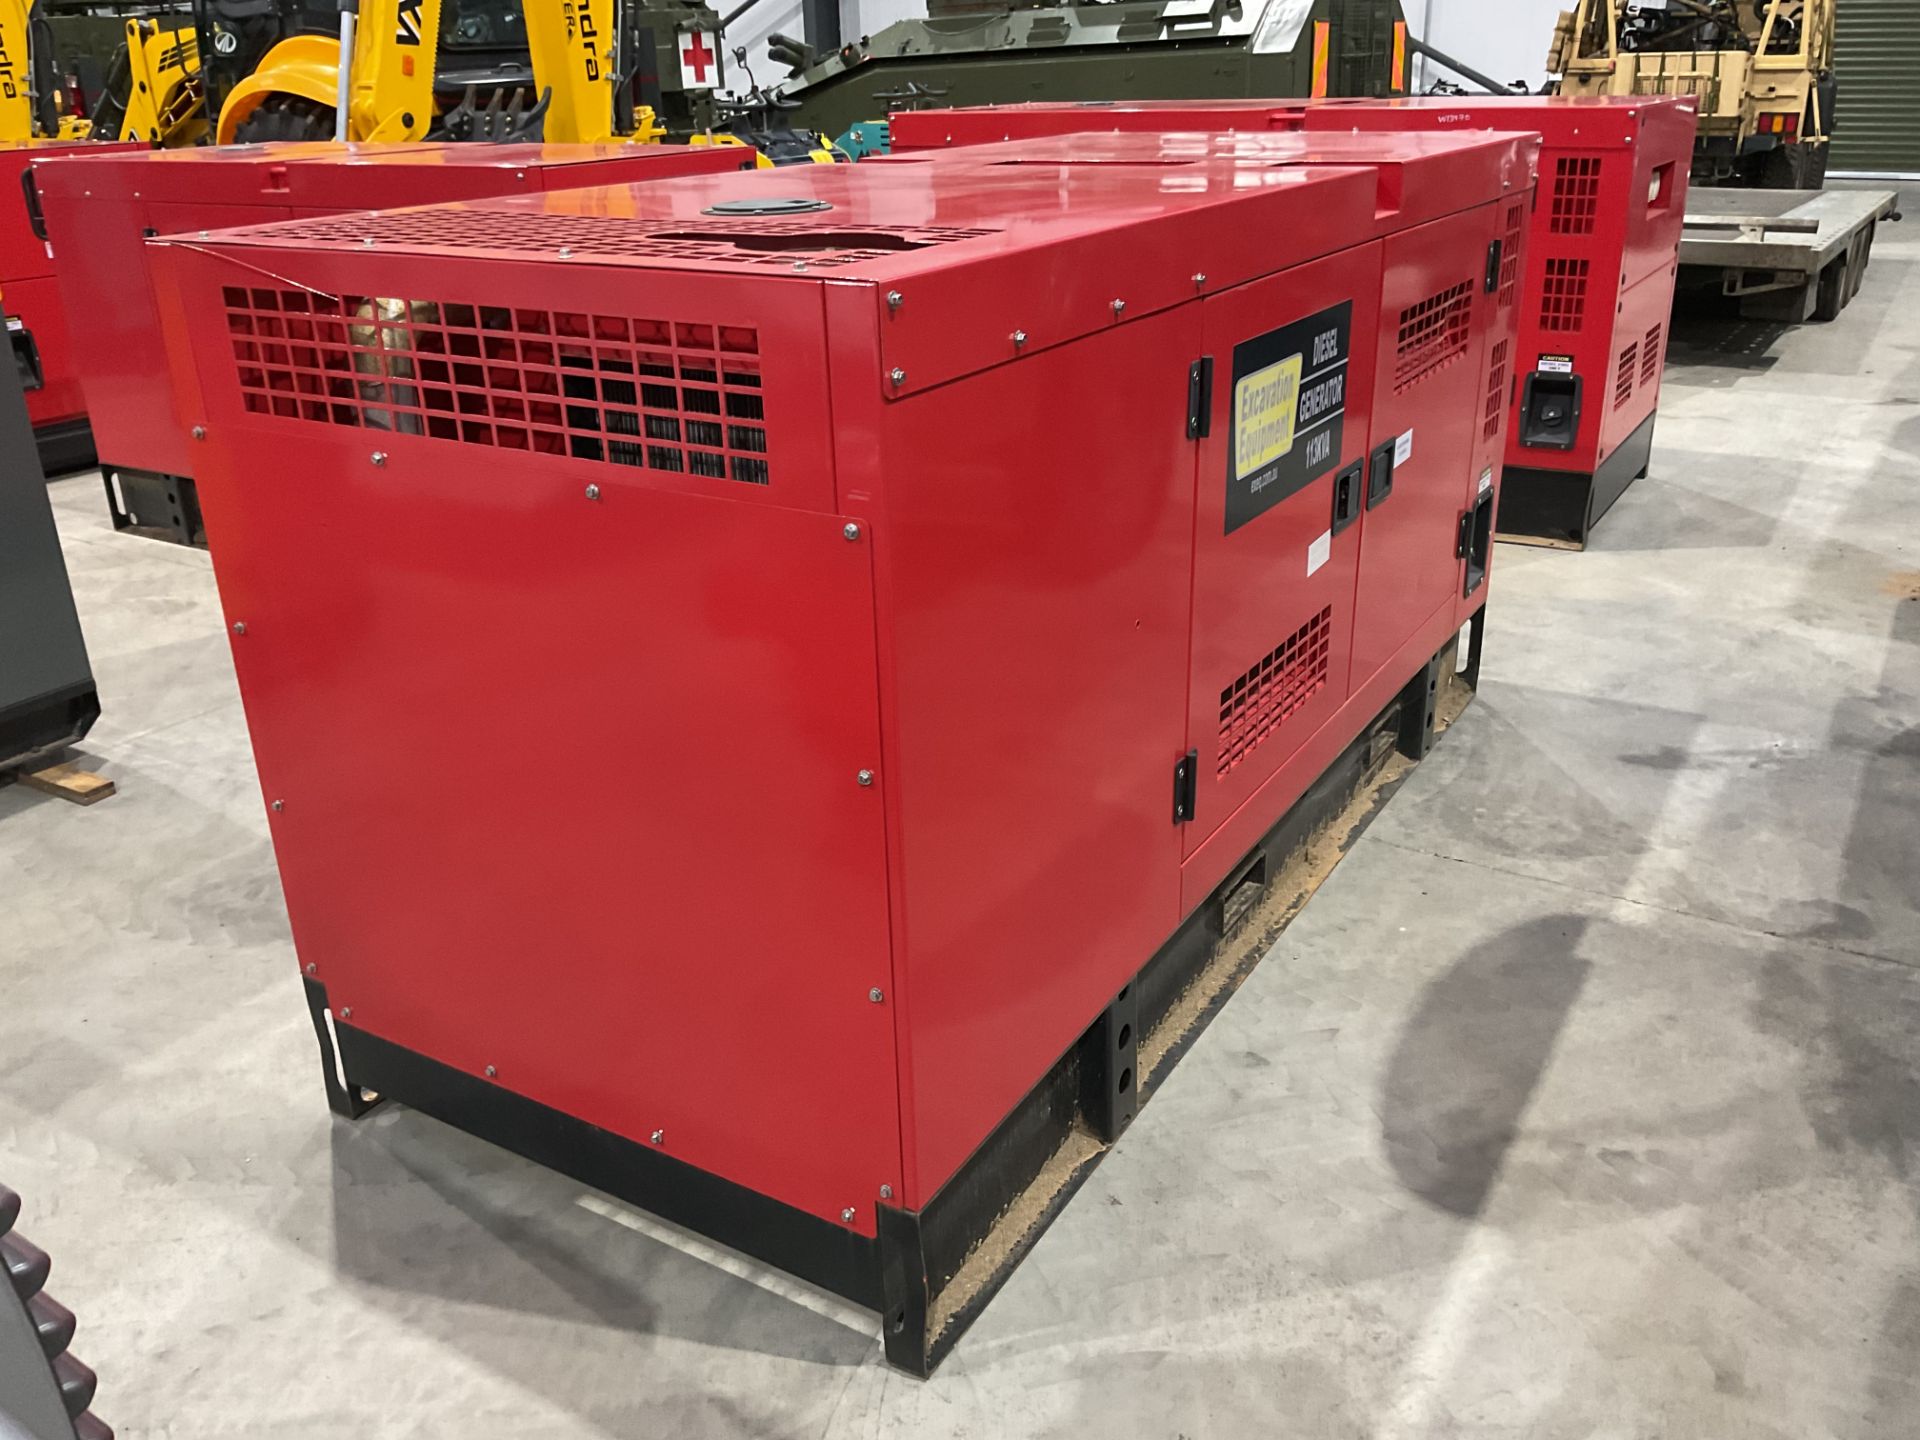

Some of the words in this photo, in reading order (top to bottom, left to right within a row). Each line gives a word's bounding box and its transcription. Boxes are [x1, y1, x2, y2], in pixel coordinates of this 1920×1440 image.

[1312, 327, 1338, 367] DIESEL
[1241, 369, 1295, 422] Excavation
[1299, 374, 1343, 423] GENERATOR
[1239, 412, 1291, 467] Equipment
[1306, 429, 1331, 469] 113KVA
